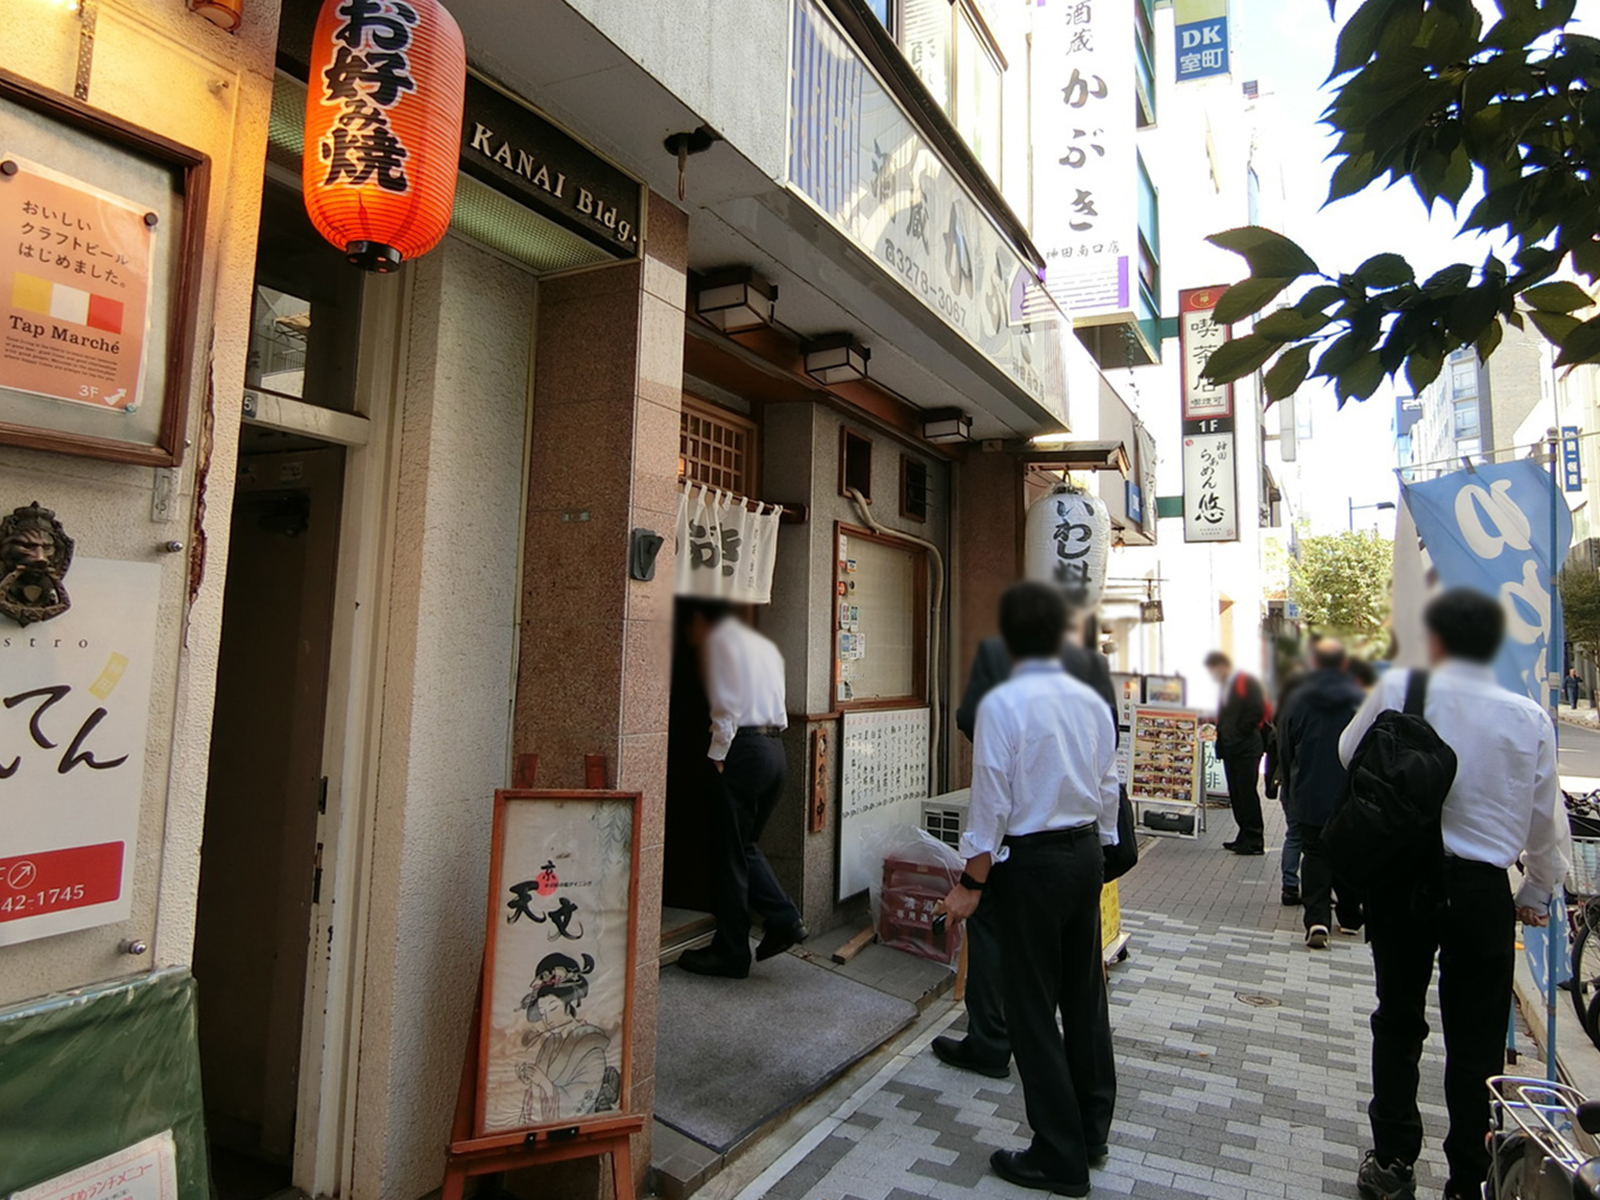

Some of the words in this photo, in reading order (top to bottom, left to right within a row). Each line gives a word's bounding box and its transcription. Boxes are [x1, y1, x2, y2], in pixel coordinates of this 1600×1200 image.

[1065, 0, 1093, 56] 酒蔵
[1181, 24, 1221, 49] DK
[1179, 48, 1224, 74] 室町
[1059, 67, 1108, 232] かぶき
[470, 122, 566, 199] KANAI
[575, 187, 637, 243] Bldg.
[22, 200, 92, 231] おいしい
[21, 222, 129, 265] クラフトビール
[18, 241, 126, 289] はじめました。
[896, 248, 967, 328] 3278-3067
[9, 314, 45, 338] Tap
[51, 325, 120, 355] Marché
[79, 385, 99, 398] 3F
[1199, 420, 1218, 433] 1F
[1195, 491, 1226, 524] 悠
